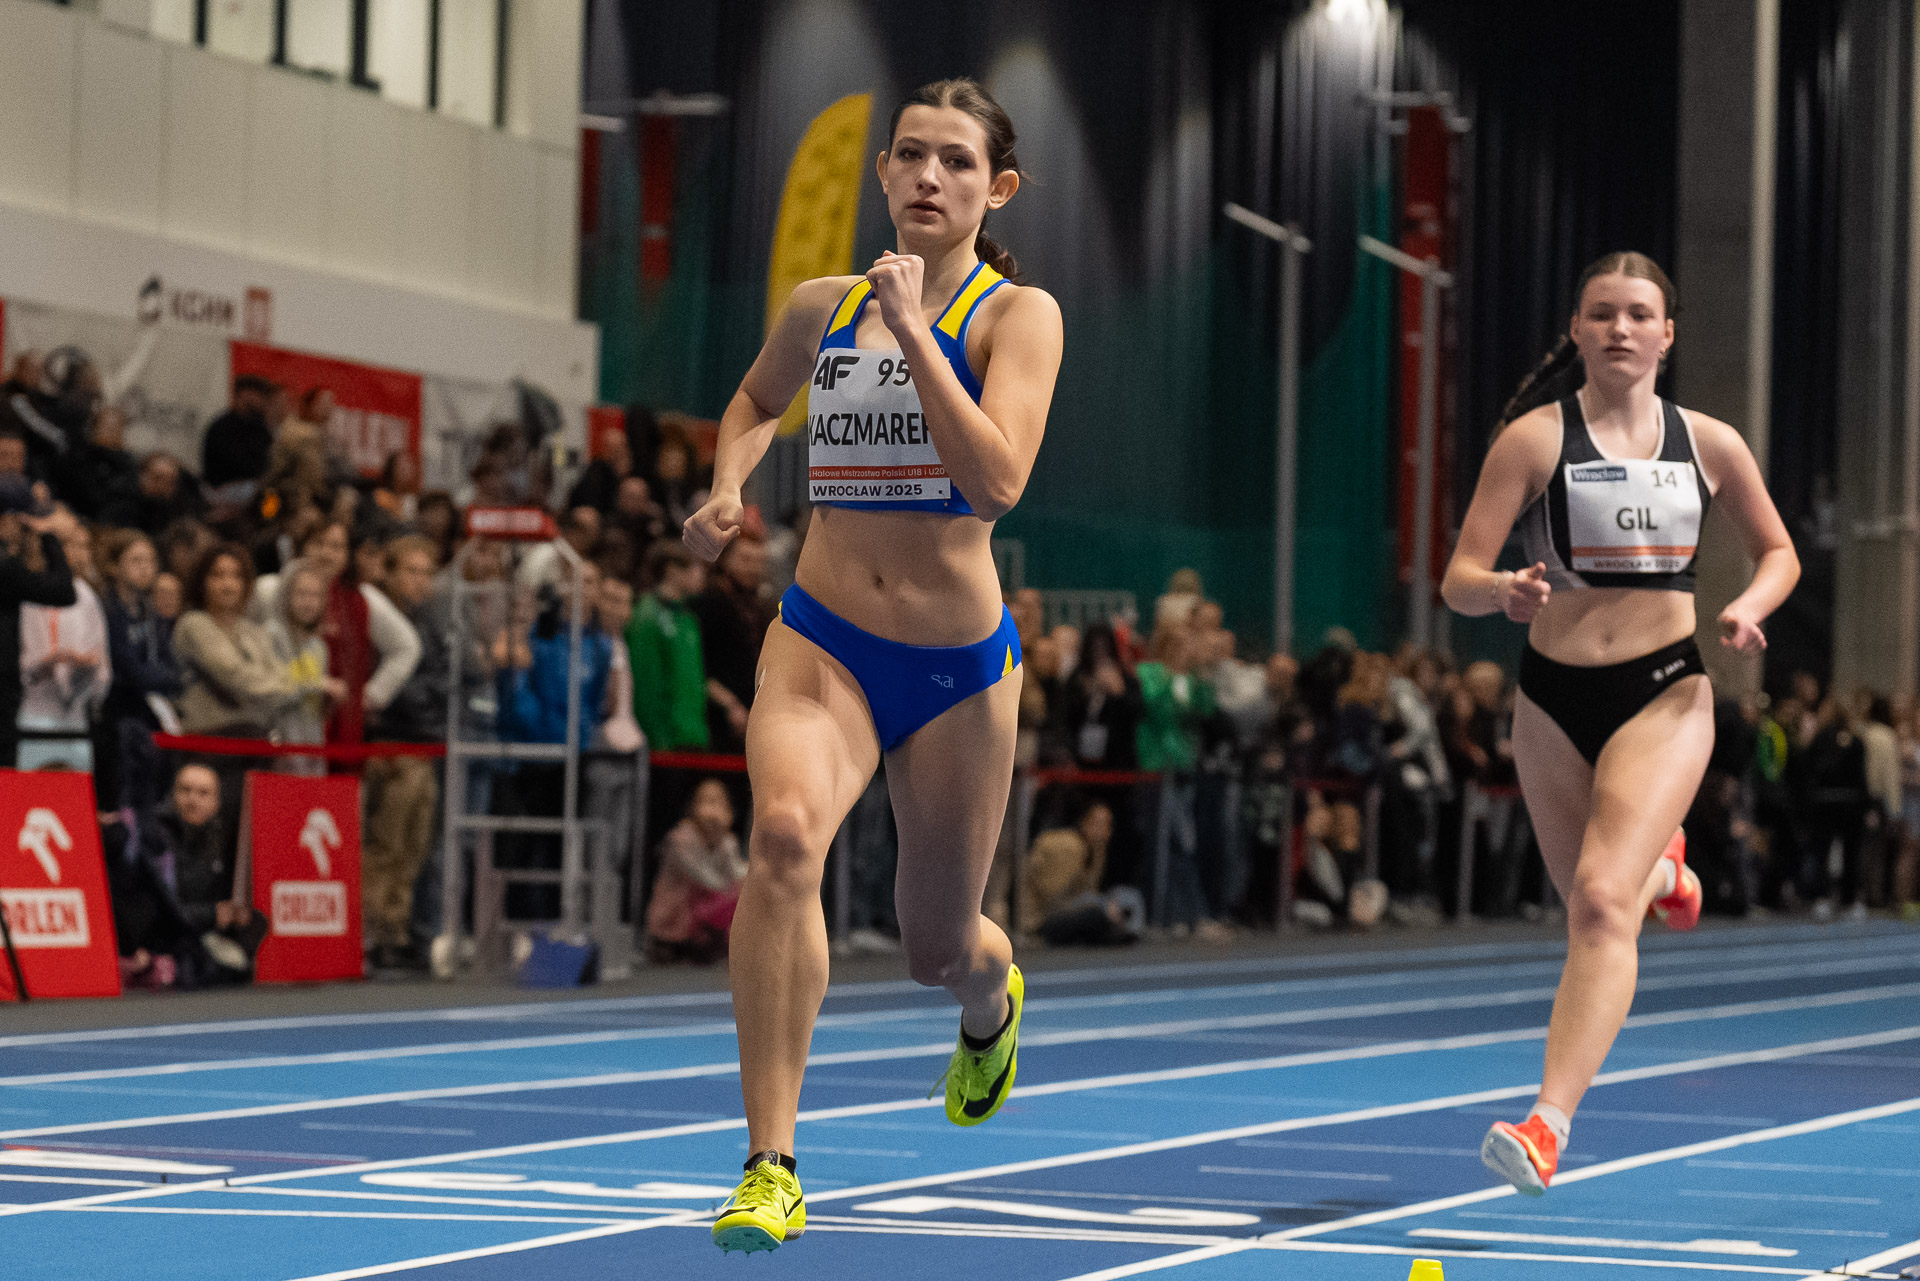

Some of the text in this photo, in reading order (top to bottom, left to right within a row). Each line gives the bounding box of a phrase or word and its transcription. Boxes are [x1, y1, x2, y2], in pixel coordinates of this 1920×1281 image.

[814, 355, 861, 391] 4F
[812, 469, 841, 478] Halowe
[841, 469, 881, 477] Mistrzostwa
[881, 468, 906, 477] Polski
[907, 468, 922, 477] U18
[928, 467, 945, 475] U20
[1651, 468, 1677, 489] 14
[812, 484, 923, 497] WROCŁAW 2025
[1616, 506, 1658, 531] GIL
